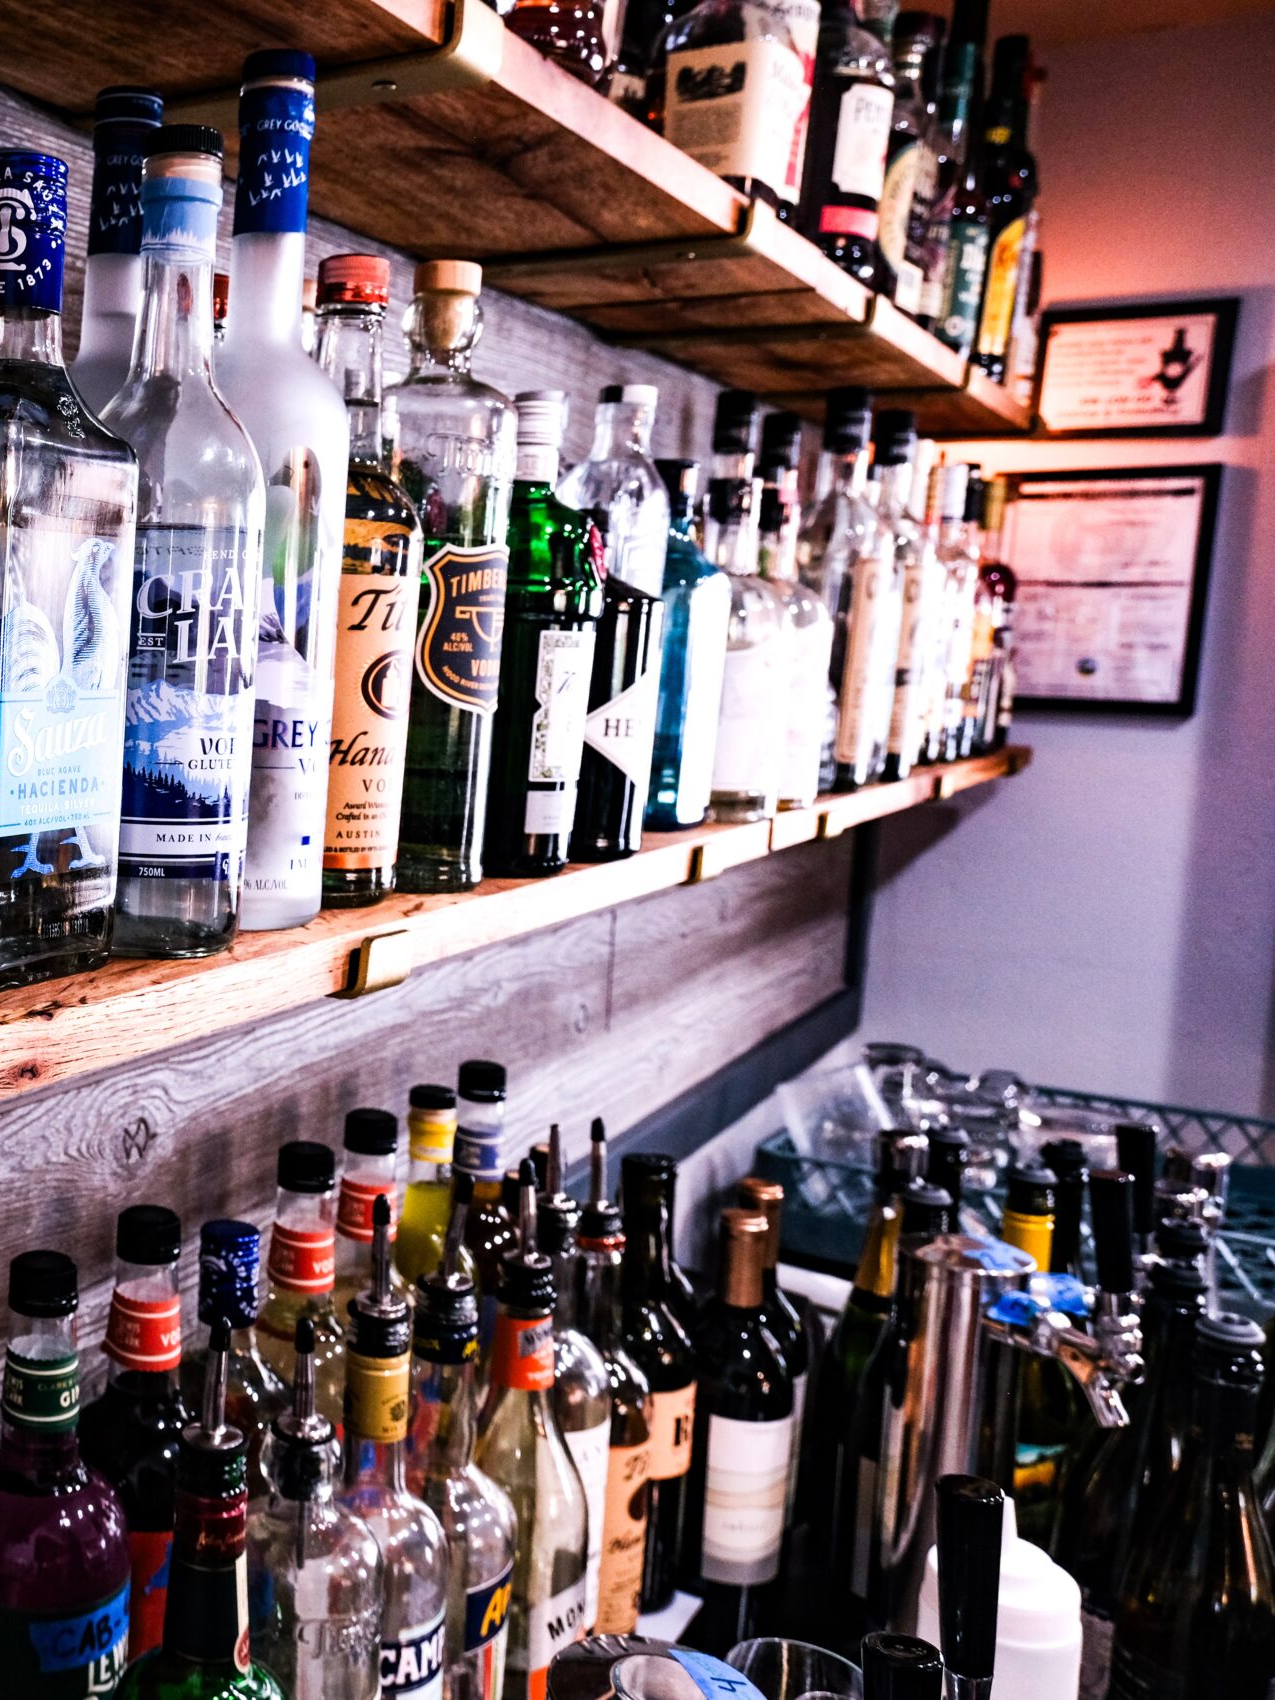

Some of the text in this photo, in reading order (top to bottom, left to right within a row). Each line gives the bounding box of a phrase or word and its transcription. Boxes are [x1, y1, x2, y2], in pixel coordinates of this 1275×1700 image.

[257, 119, 282, 132] GREY
[17, 258, 52, 291] 1873
[136, 567, 251, 618] CRA
[253, 719, 318, 749] GREY
[603, 718, 635, 738] HE
[7, 706, 109, 778] Sauza
[58, 765, 82, 775] AGAVE
[17, 776, 100, 801] HACIENDA
[20, 803, 60, 815] TEQUILA
[155, 833, 212, 843] MADE IN
[138, 866, 166, 878] 750ML
